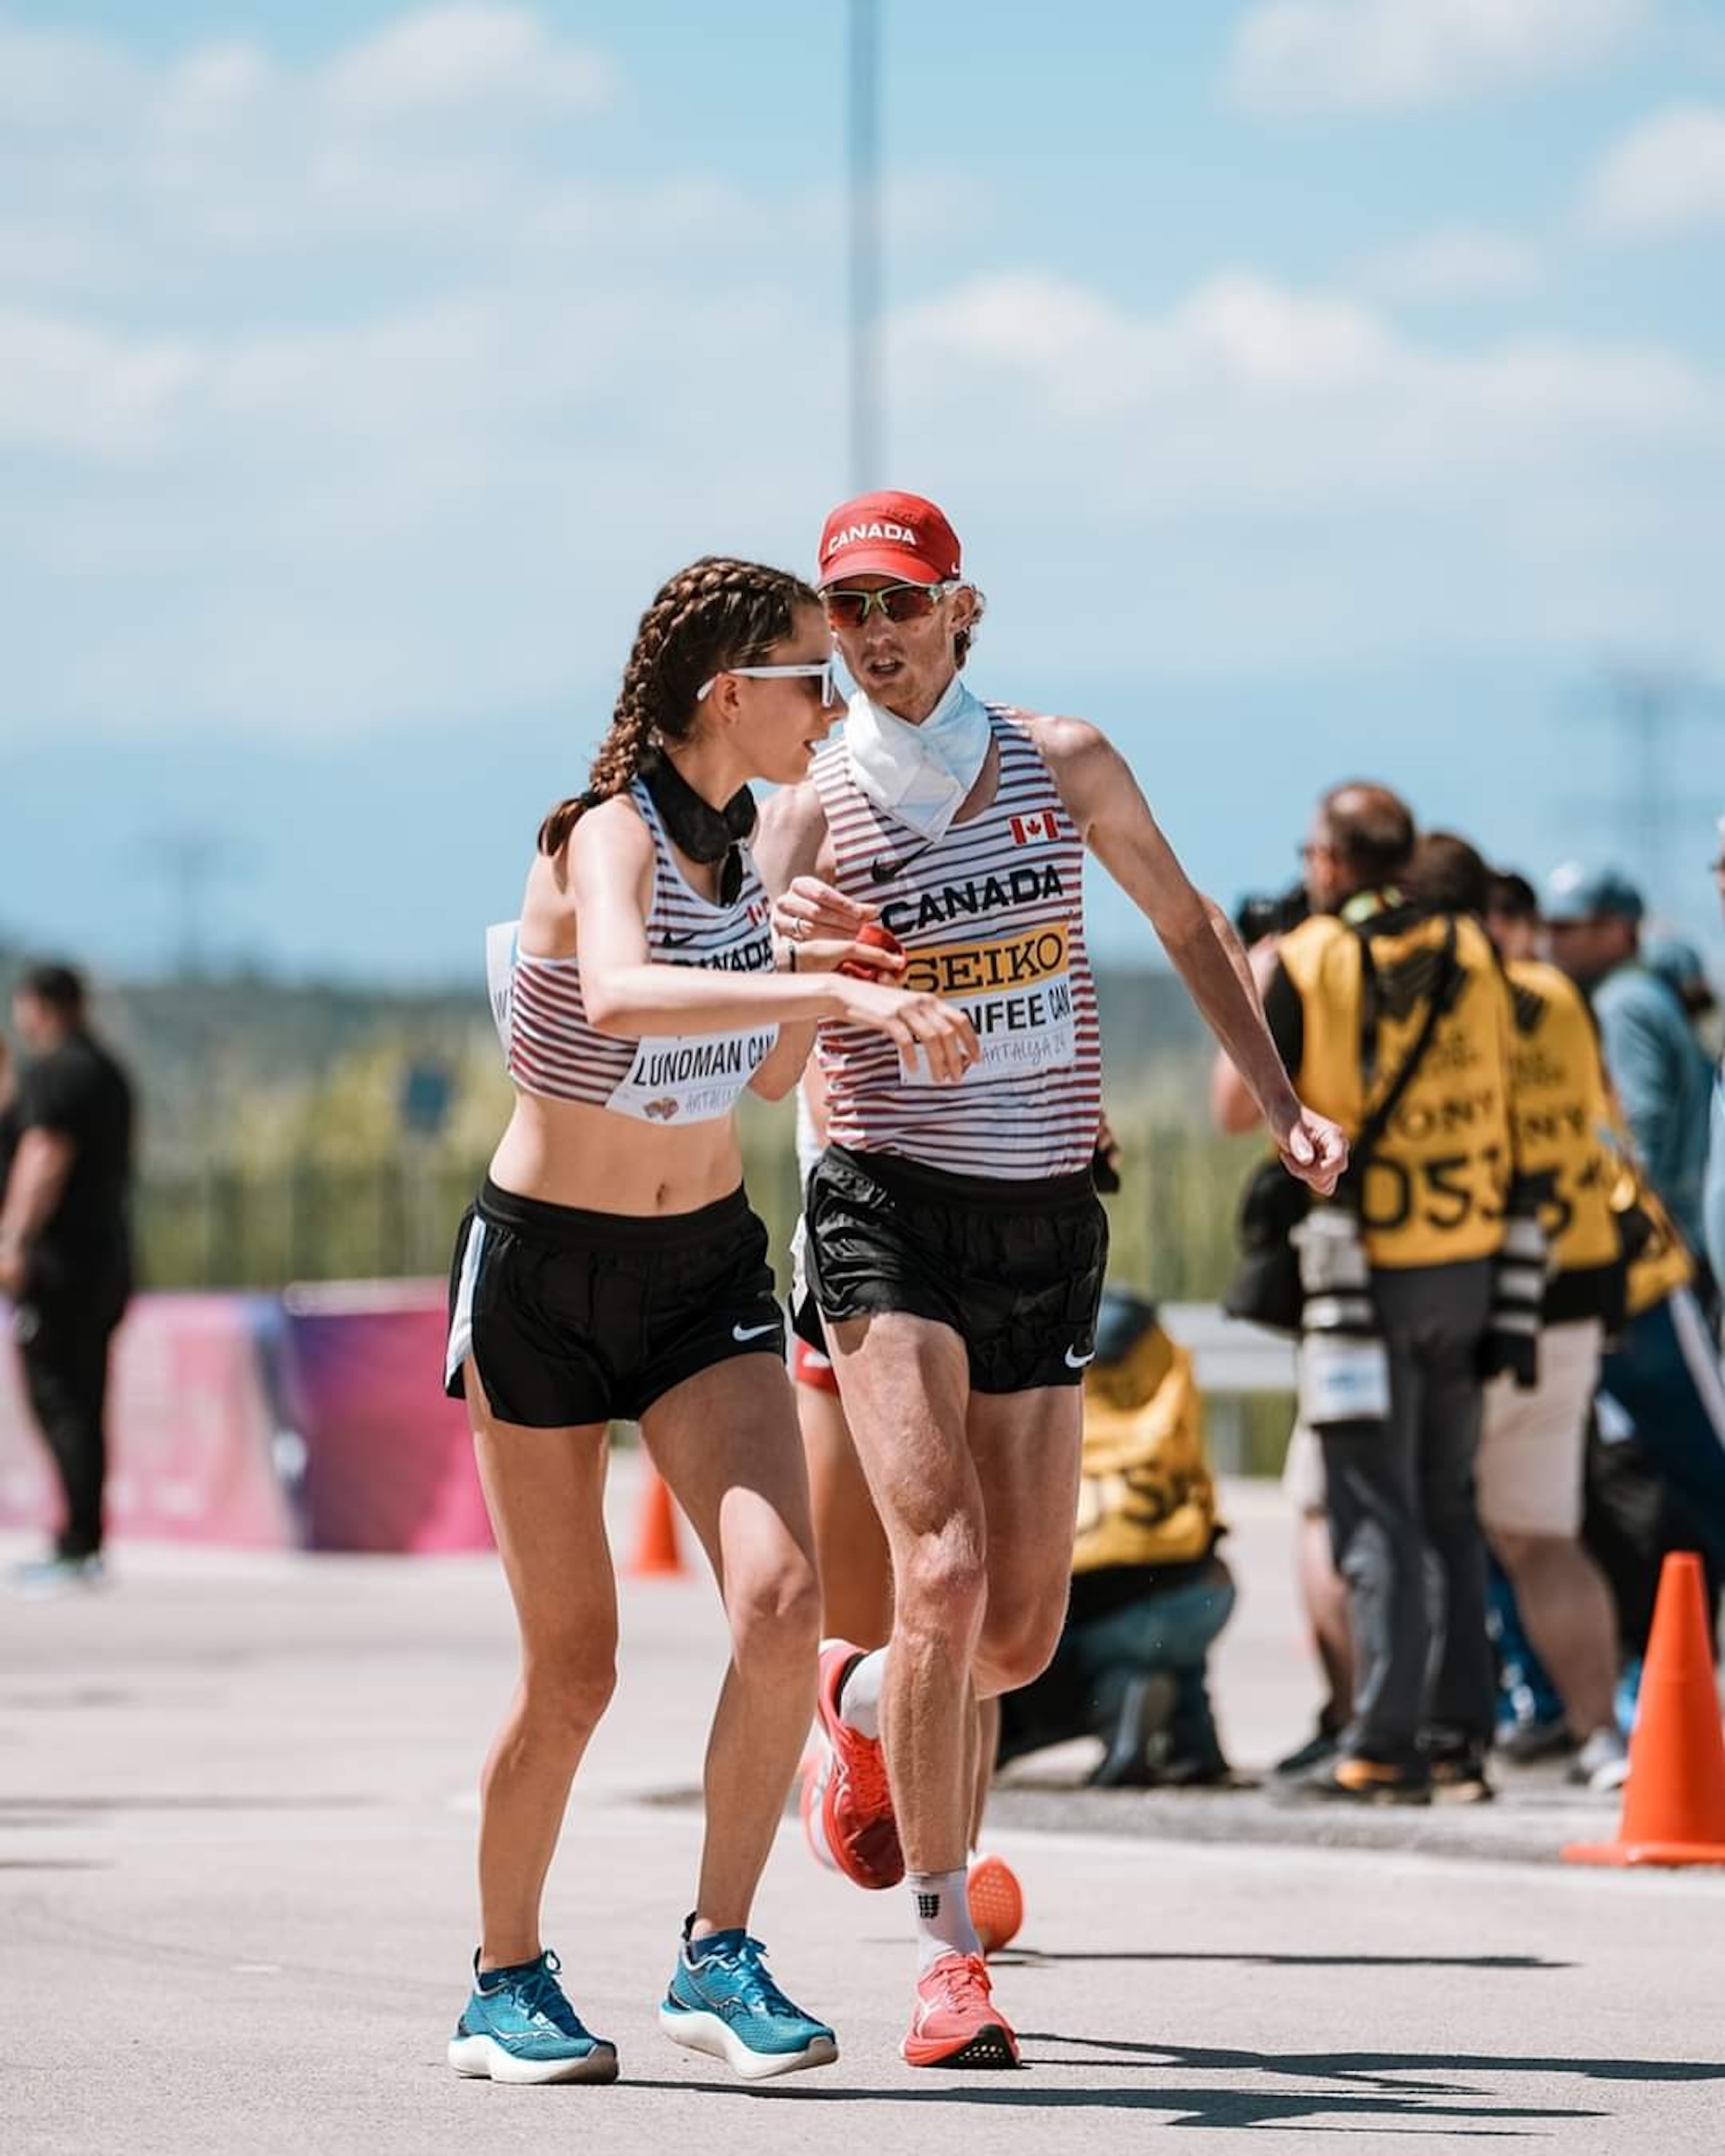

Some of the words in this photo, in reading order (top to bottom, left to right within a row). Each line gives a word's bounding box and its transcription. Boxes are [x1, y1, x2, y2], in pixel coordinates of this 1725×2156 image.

[827, 523, 916, 555] CANADA
[880, 864, 1064, 935] CANADA
[670, 934, 773, 971] NADA
[903, 932, 1063, 993] SEIKO
[959, 994, 1047, 1036] NFEE
[632, 1039, 742, 1086] LUNDMAN
[1389, 1089, 1495, 1140] ONY
